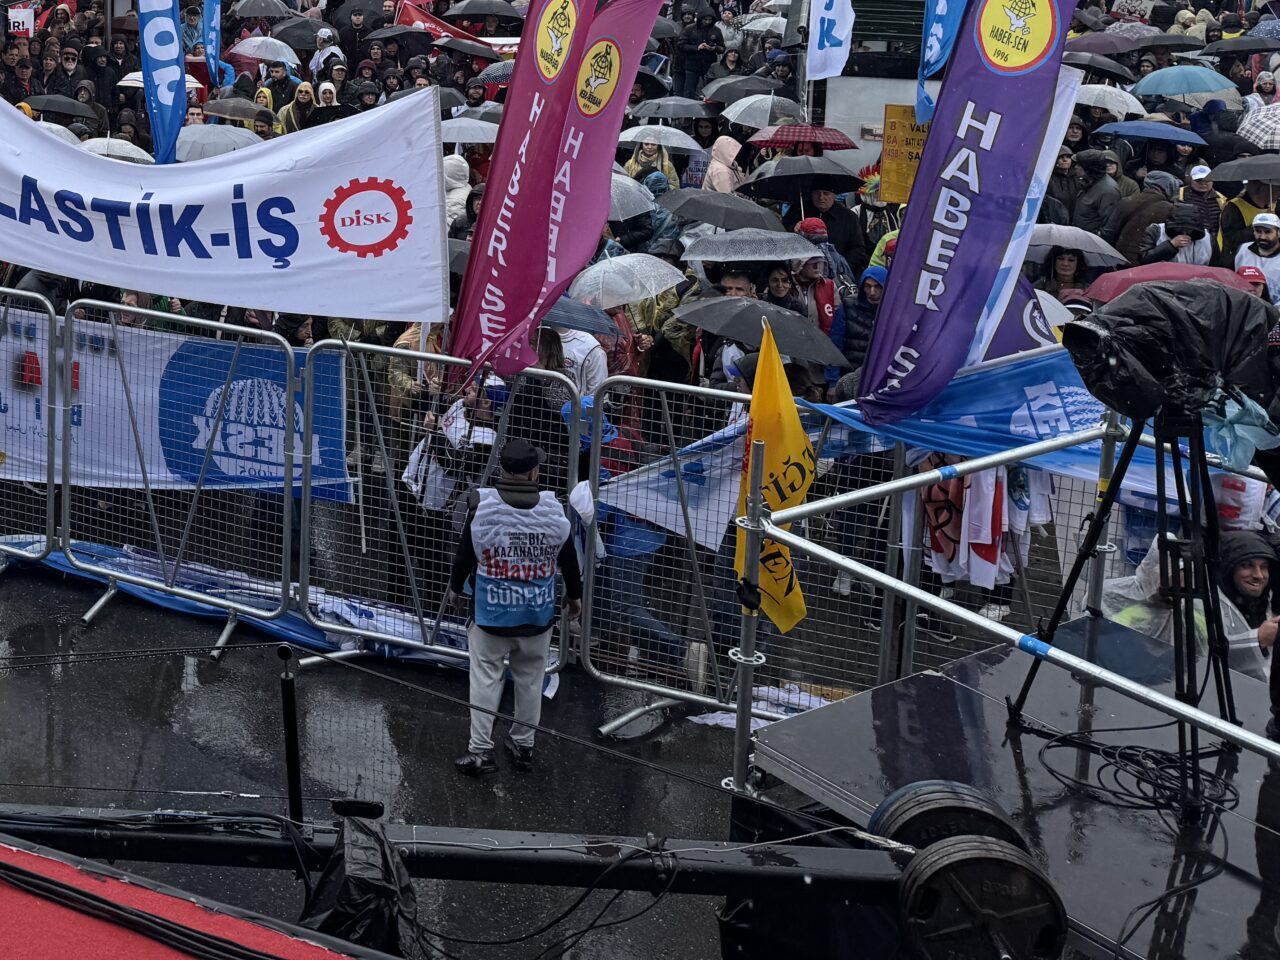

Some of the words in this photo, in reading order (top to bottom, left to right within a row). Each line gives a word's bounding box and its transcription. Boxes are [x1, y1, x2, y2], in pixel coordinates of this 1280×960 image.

[990, 24, 1029, 53] HABER-SEN
[992, 47, 1009, 63] 1996
[908, 151, 921, 162] ŞA
[339, 207, 392, 228] DİSK
